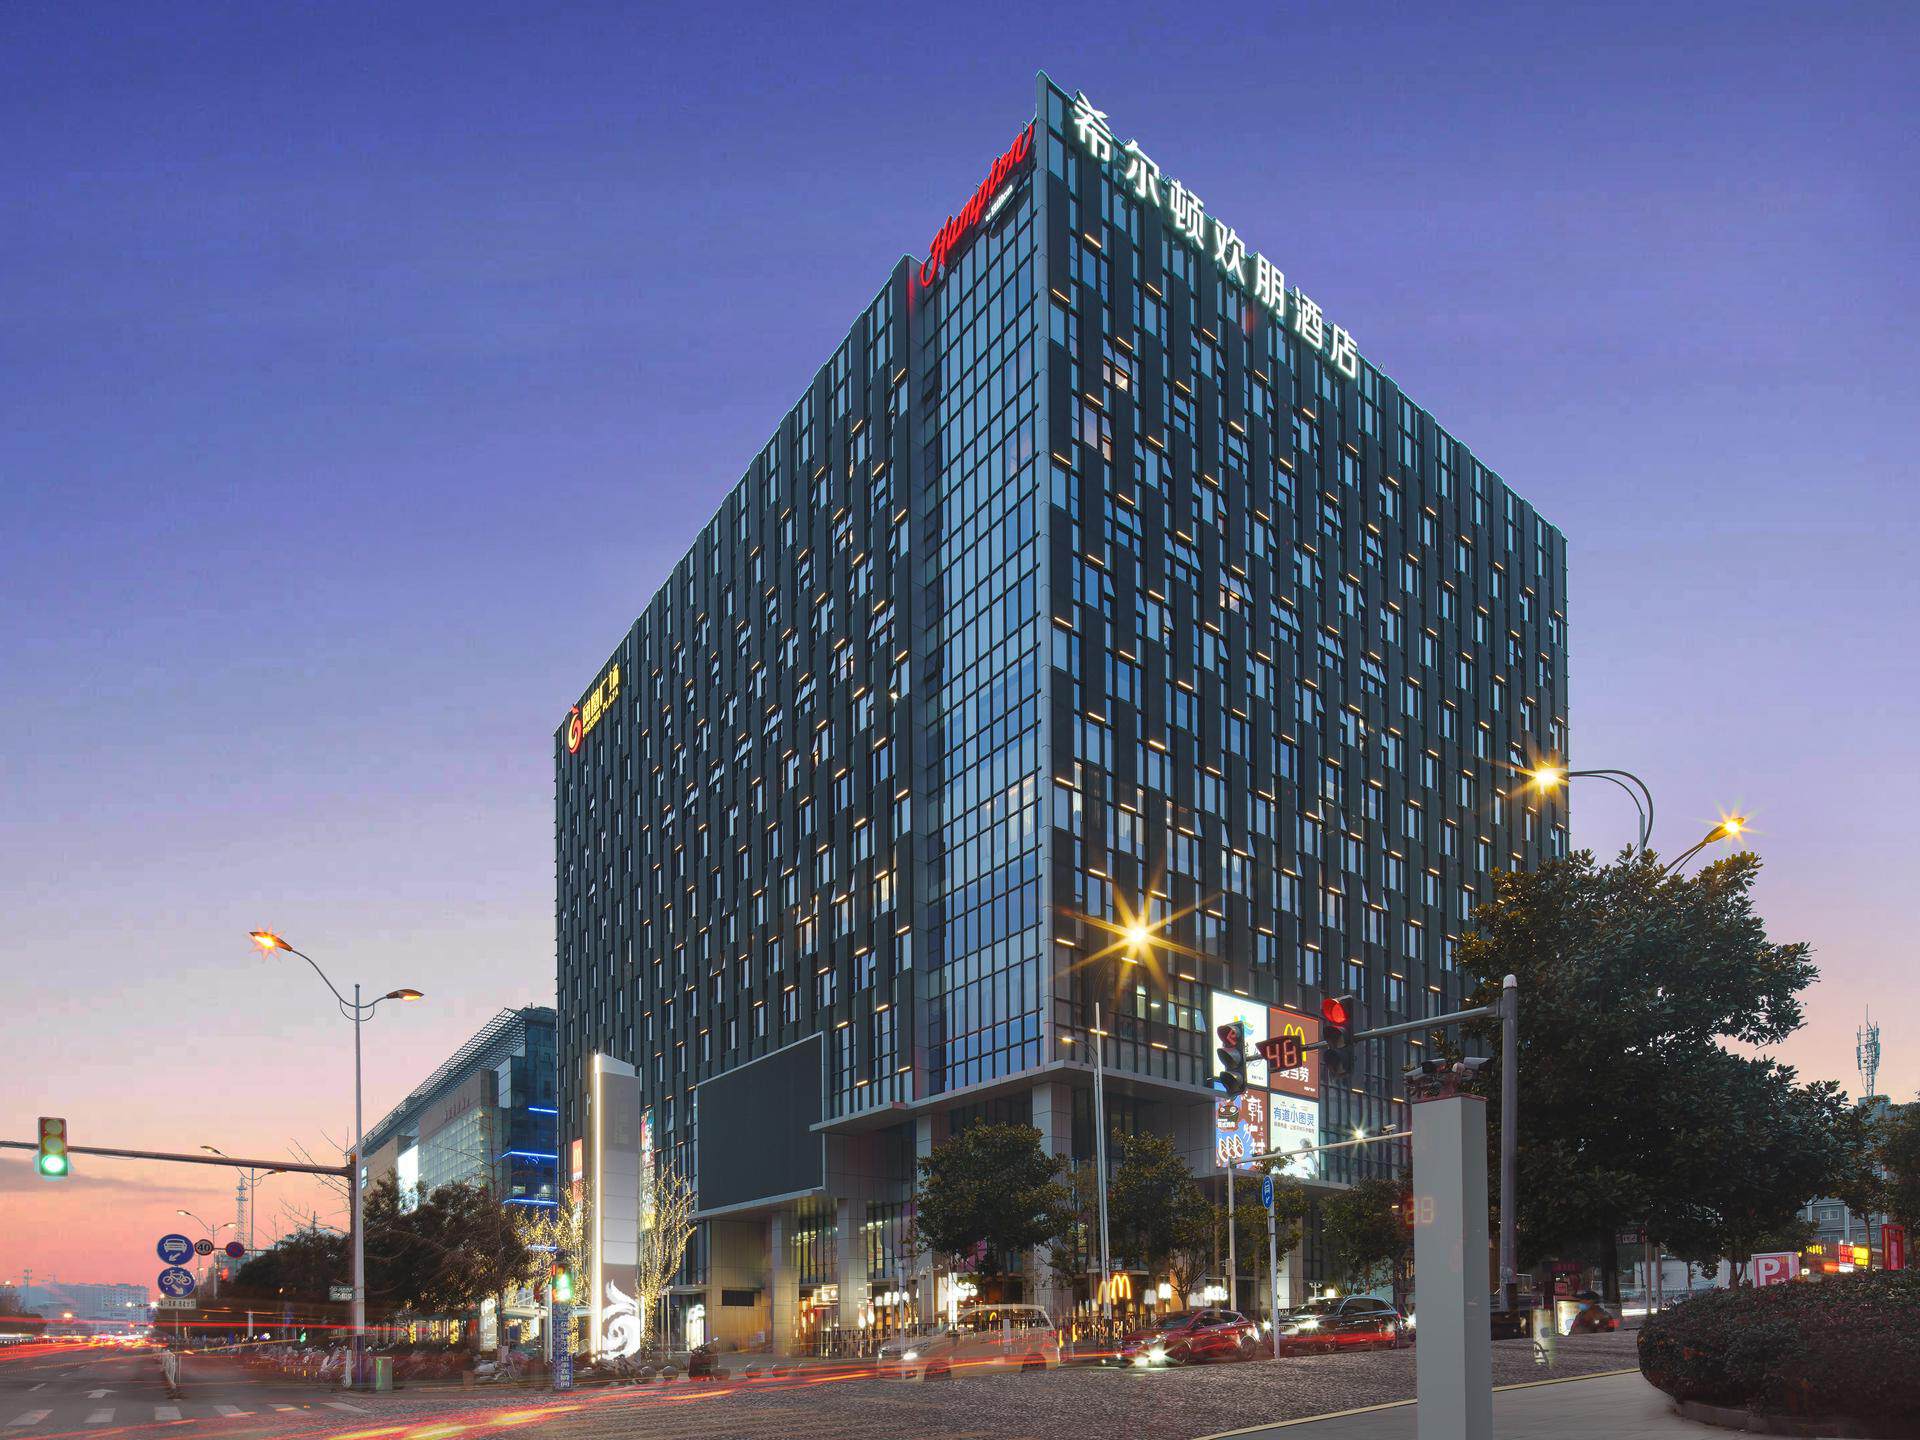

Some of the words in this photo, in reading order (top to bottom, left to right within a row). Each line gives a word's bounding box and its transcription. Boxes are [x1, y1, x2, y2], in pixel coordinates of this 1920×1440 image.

[920, 124, 1035, 287] Hampton
[1074, 90, 1357, 378] 希尔顿欢朋酒店
[197, 1243, 211, 1252] 40
[1758, 1258, 1781, 1287] P
